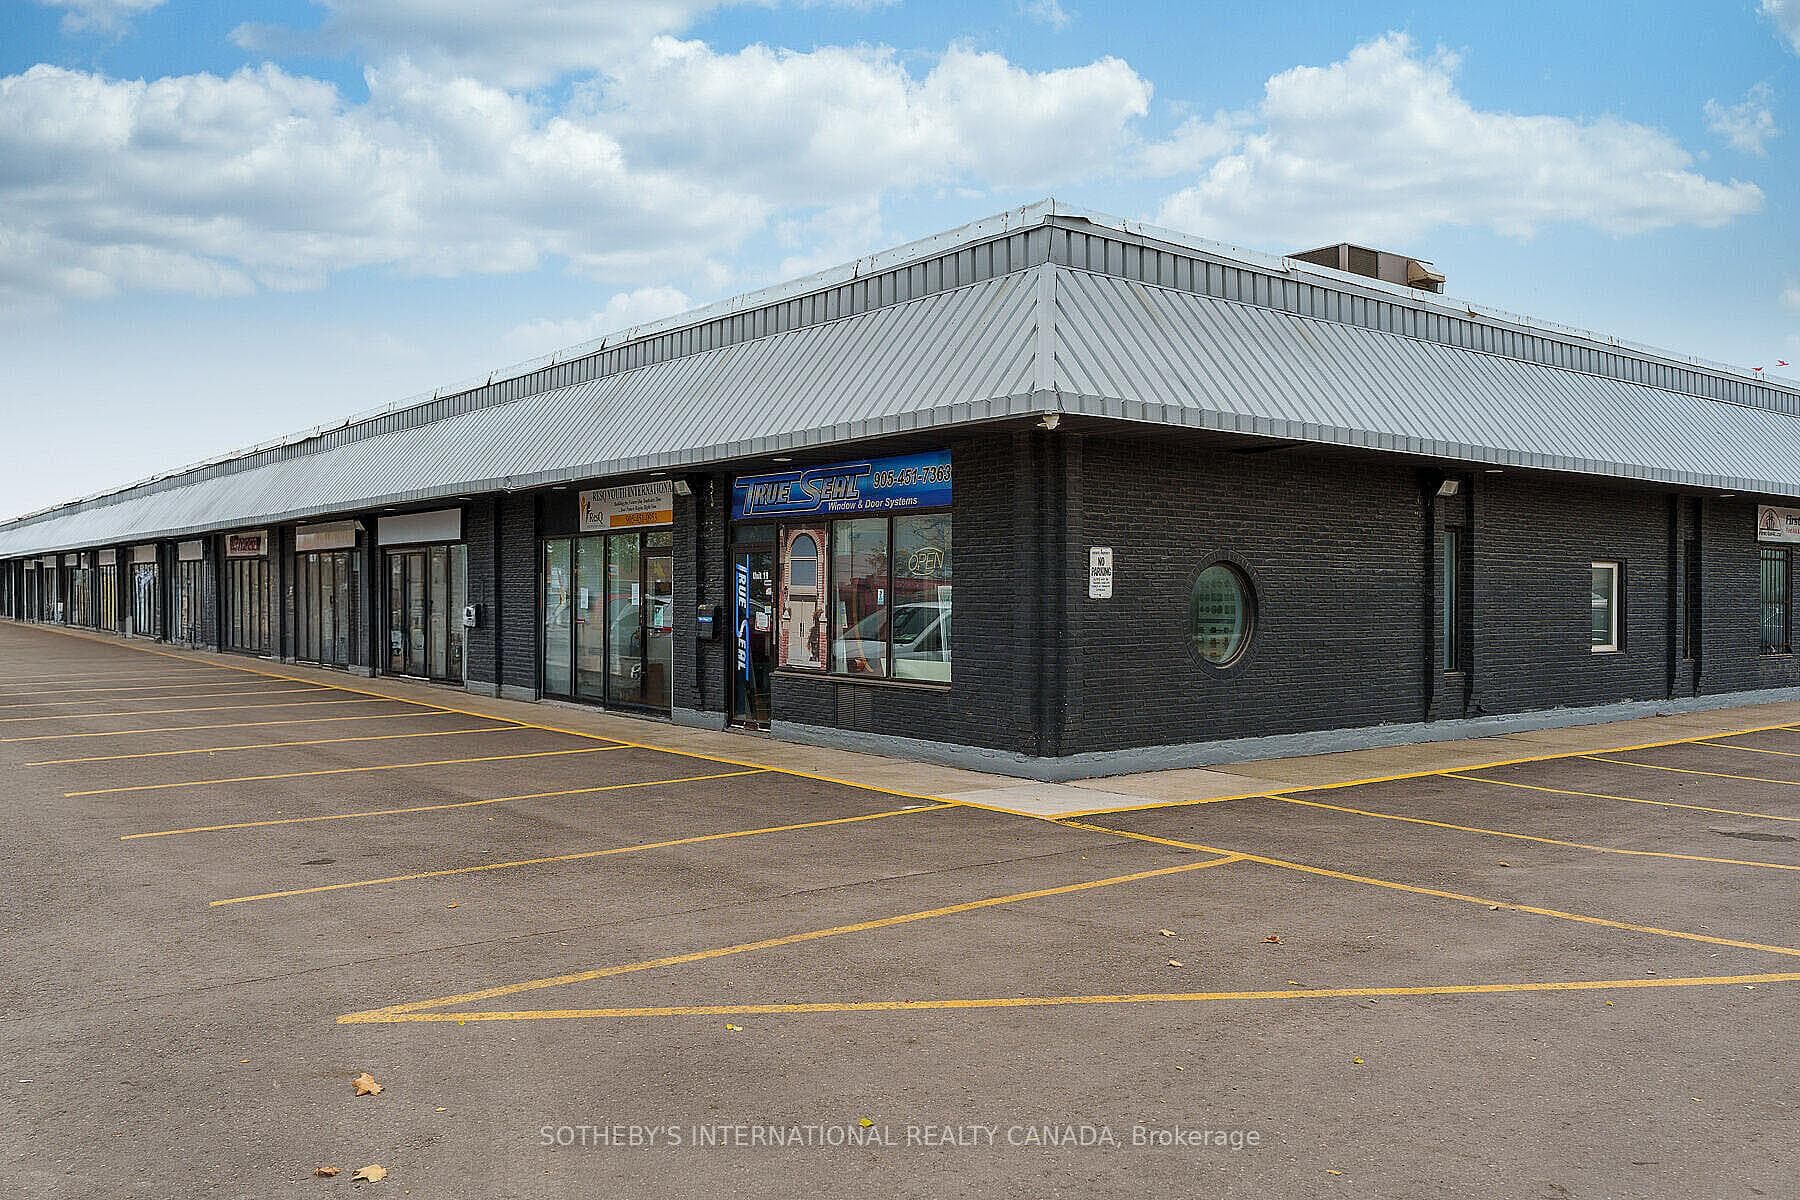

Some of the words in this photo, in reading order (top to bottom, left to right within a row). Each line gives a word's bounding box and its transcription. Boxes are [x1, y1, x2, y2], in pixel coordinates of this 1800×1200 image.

[873, 464, 952, 488] 905-451-7363
[607, 485, 627, 500] YOUTH
[627, 482, 672, 497] INTERNATIONA
[735, 471, 801, 515] TRUE
[800, 464, 871, 511] SEAL
[828, 501, 856, 511] Window
[858, 499, 863, 509] &
[865, 499, 883, 509] Door
[884, 496, 918, 508] Systems
[908, 551, 944, 572] OPEN
[1091, 567, 1111, 576] PARKING
[1097, 557, 1106, 566] NO
[736, 562, 749, 609] TRUE
[738, 619, 748, 671] SEAL
